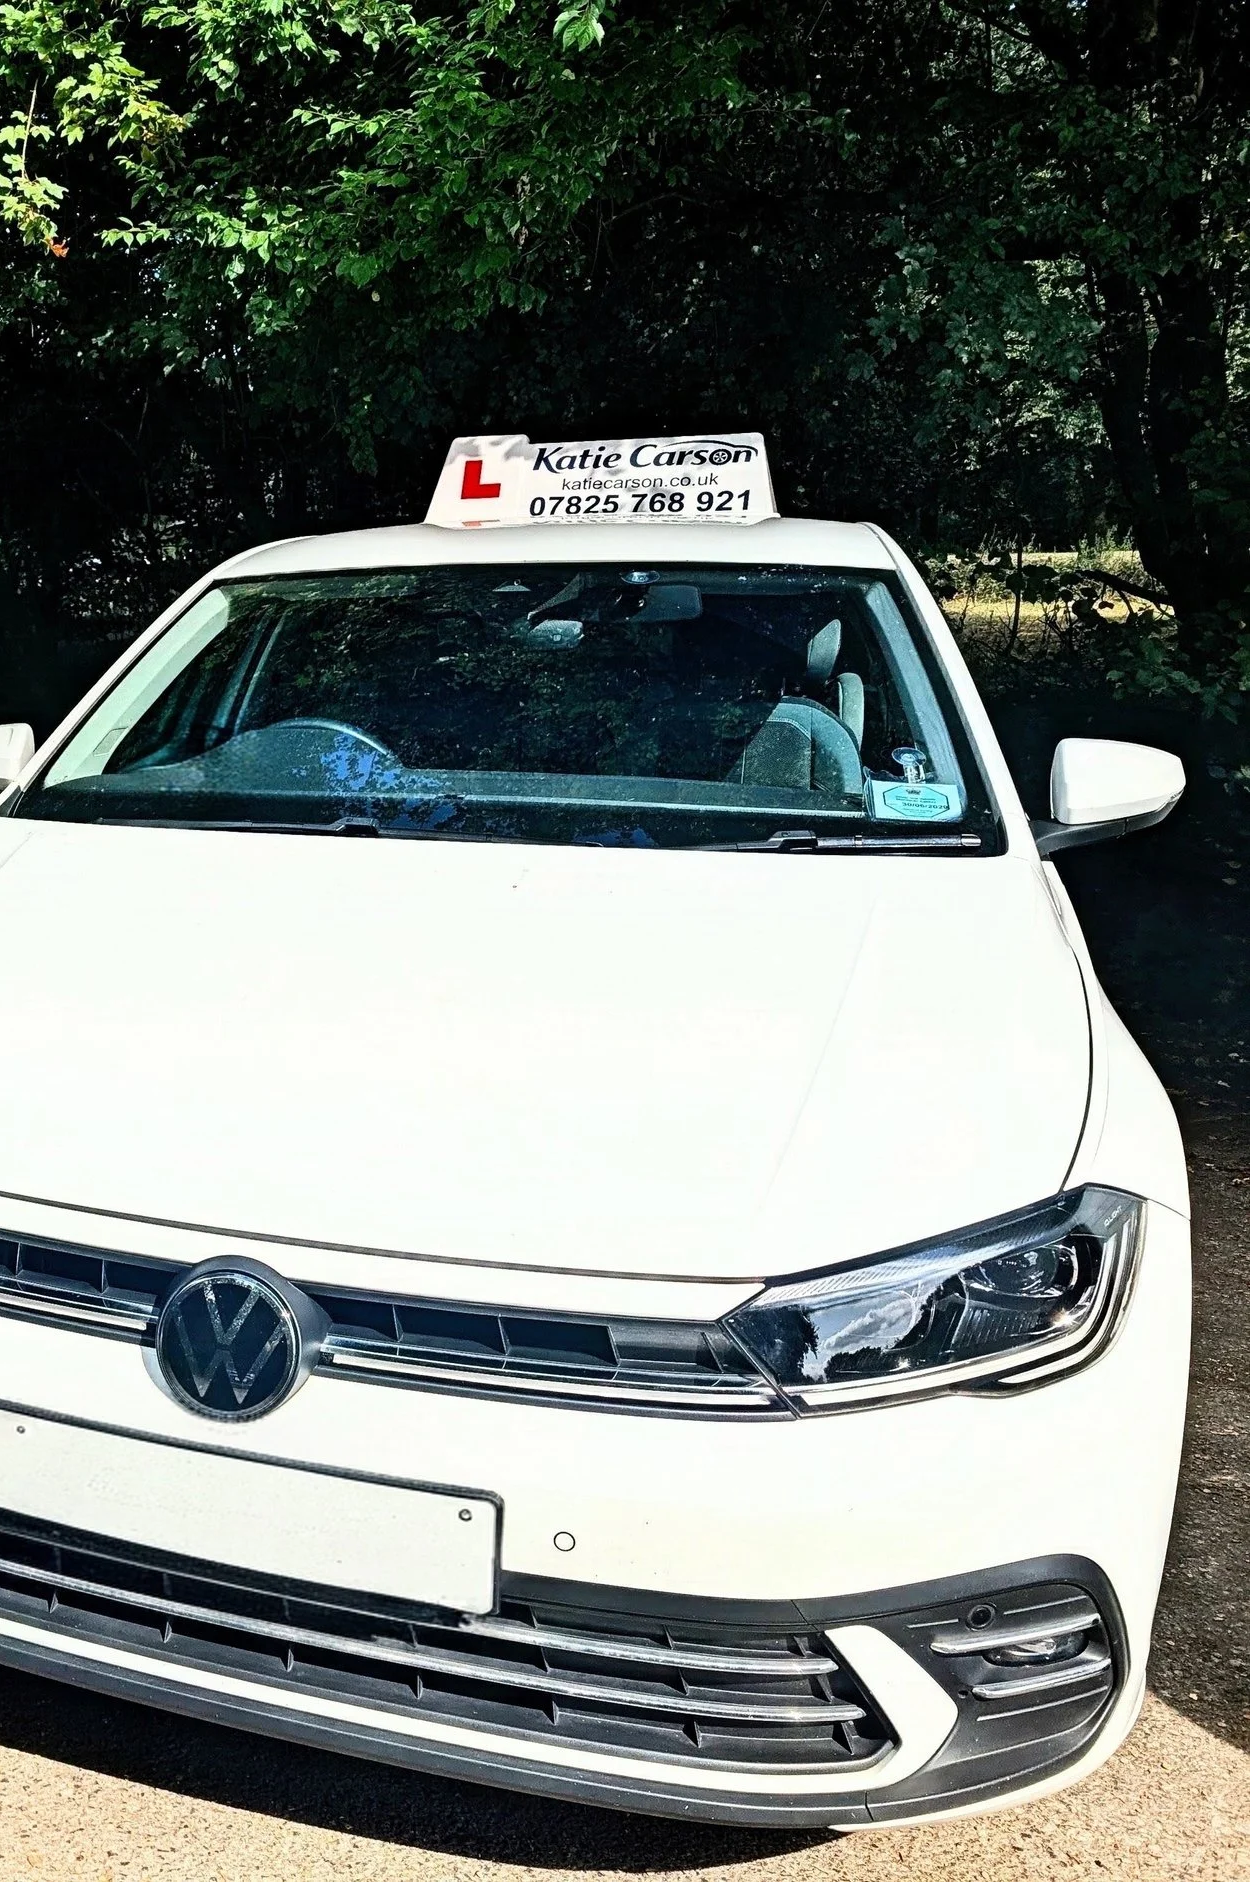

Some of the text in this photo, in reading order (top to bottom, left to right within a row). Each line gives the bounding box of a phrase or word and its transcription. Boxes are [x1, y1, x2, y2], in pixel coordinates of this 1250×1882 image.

[533, 443, 753, 474] Katie Carson
[461, 460, 501, 499] L
[562, 473, 718, 490] katiecarson.co.uk
[530, 489, 750, 516] 07825 768 921
